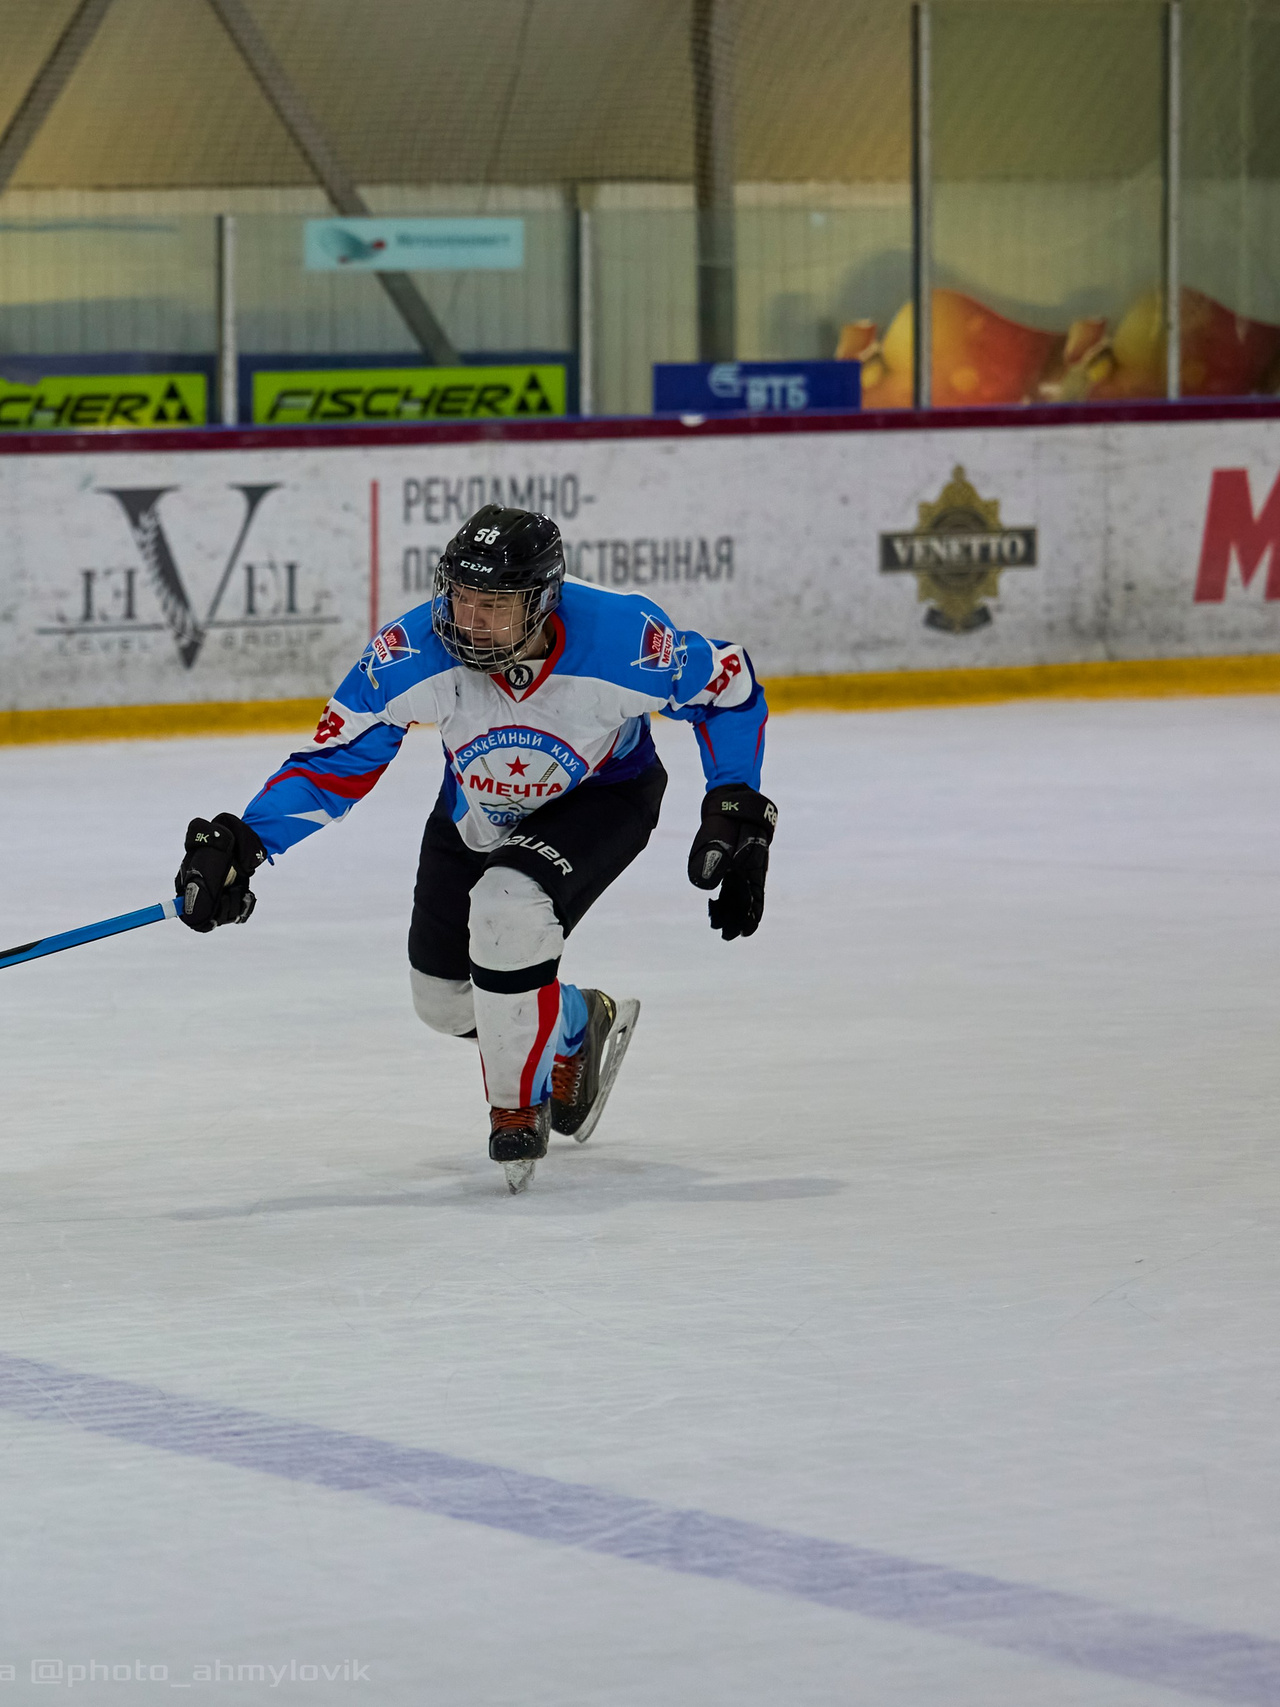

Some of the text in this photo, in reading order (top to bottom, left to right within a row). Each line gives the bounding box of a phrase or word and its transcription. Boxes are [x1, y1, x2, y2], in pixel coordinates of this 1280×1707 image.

[265, 384, 511, 421] FISCHER
[474, 528, 500, 545] 58
[892, 531, 1026, 567] VENETTO
[460, 560, 494, 574] CCM
[652, 633, 662, 652] 2021
[662, 633, 672, 664] МЕЧТА
[456, 730, 543, 765] ХОККЕЙНЫЙ
[469, 774, 563, 798] МЕЧТА
[721, 801, 739, 812] 9K
[194, 832, 210, 844] 9K
